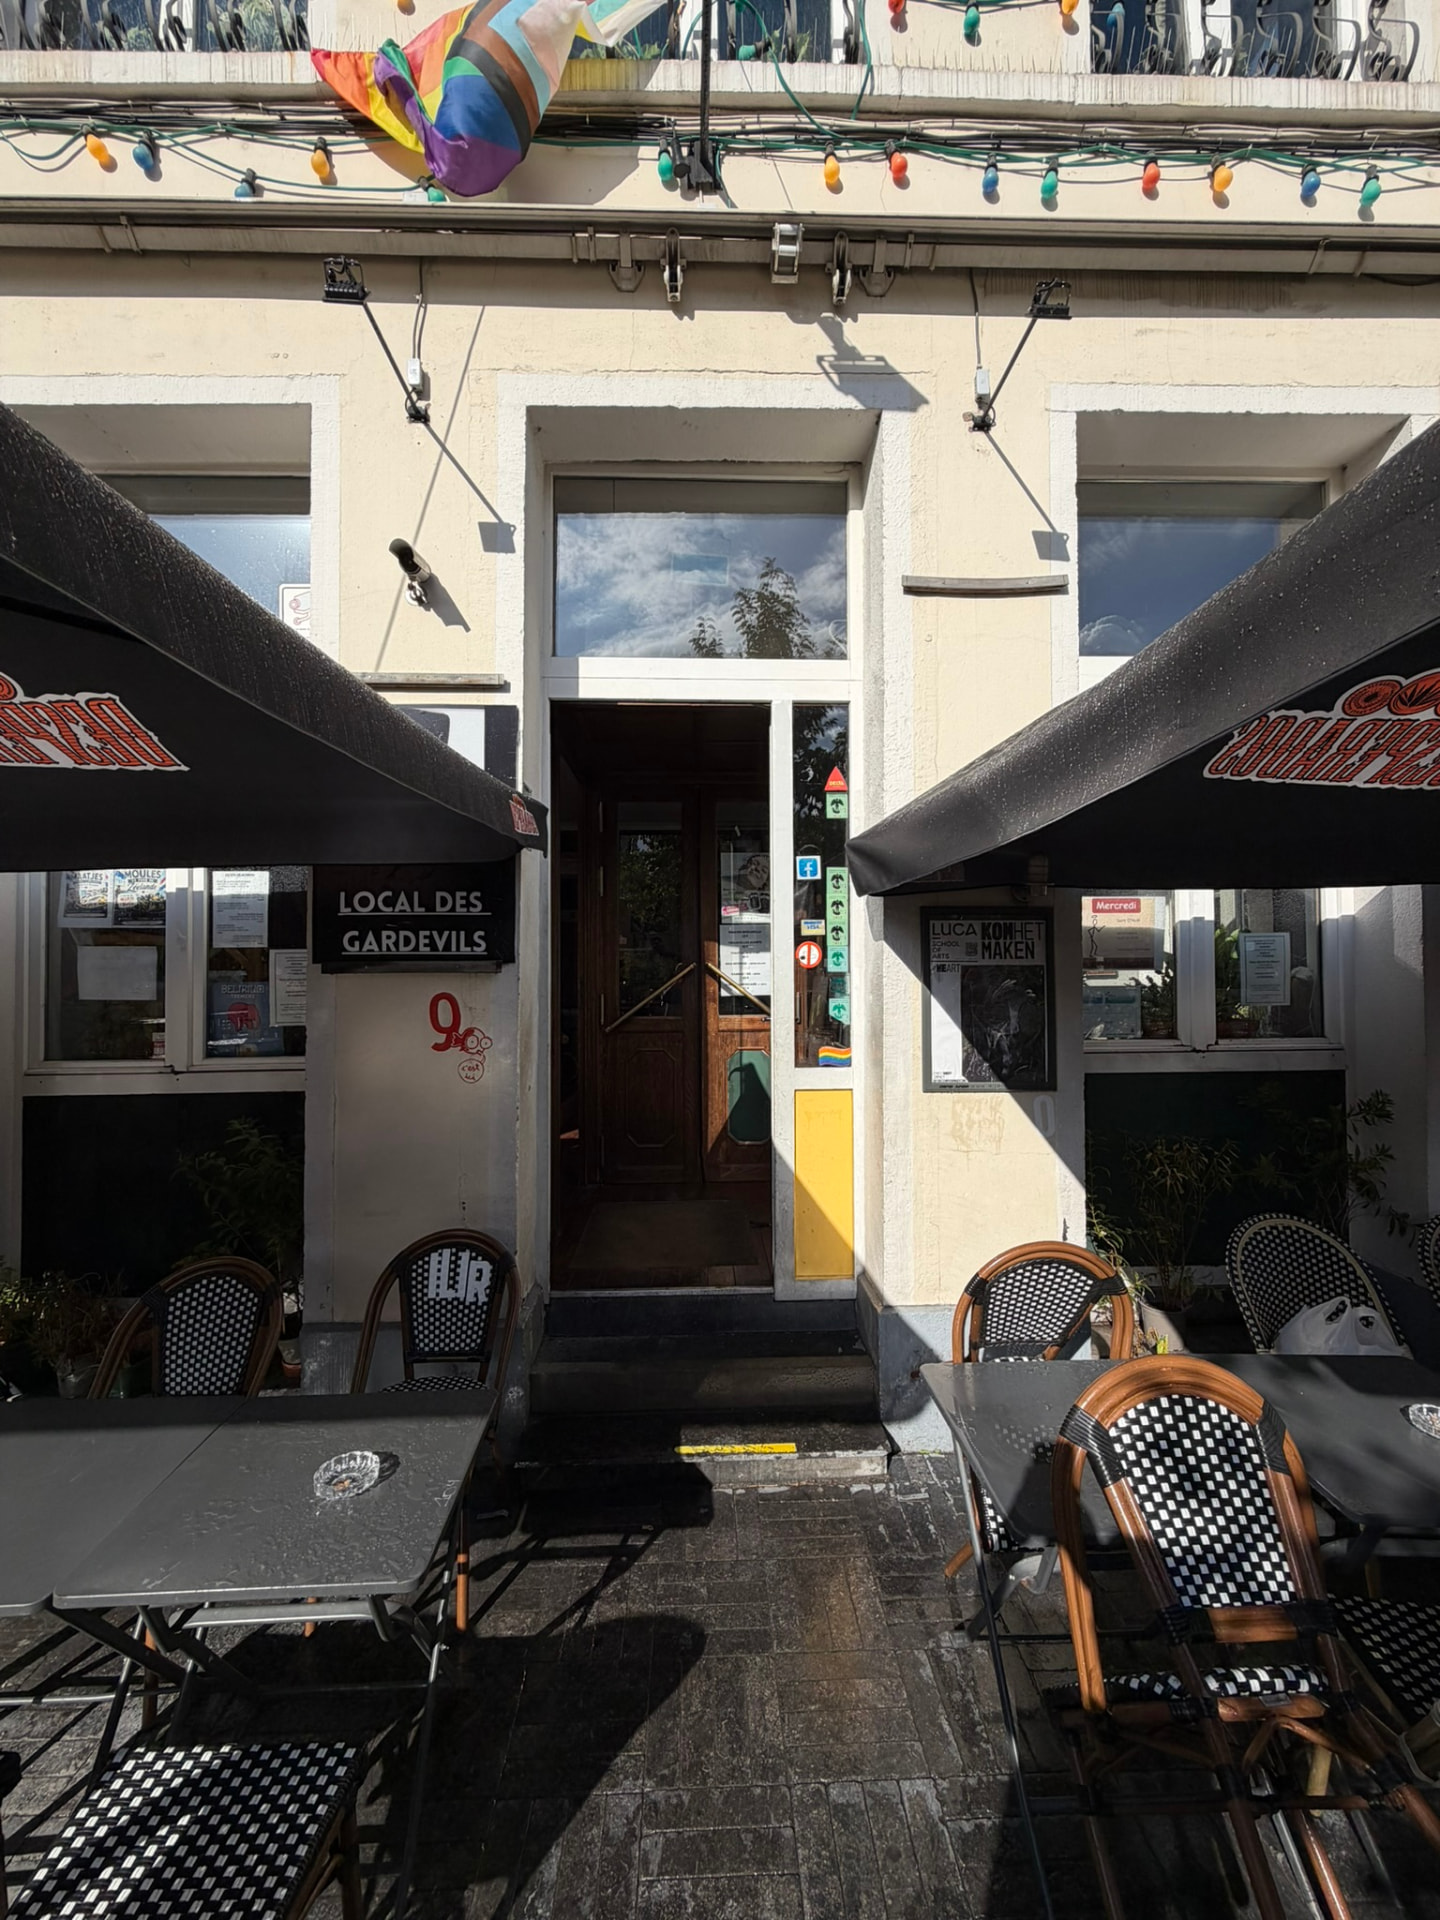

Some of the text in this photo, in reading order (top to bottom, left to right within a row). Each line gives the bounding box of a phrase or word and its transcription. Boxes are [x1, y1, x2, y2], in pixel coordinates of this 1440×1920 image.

[339, 891, 483, 913] LOCAL DES
[1096, 901, 1137, 910] Mercredi
[932, 923, 978, 936] LUCA
[342, 930, 487, 952] GARDEVILS
[982, 941, 1035, 959] MAKEN
[429, 992, 461, 1052] 9
